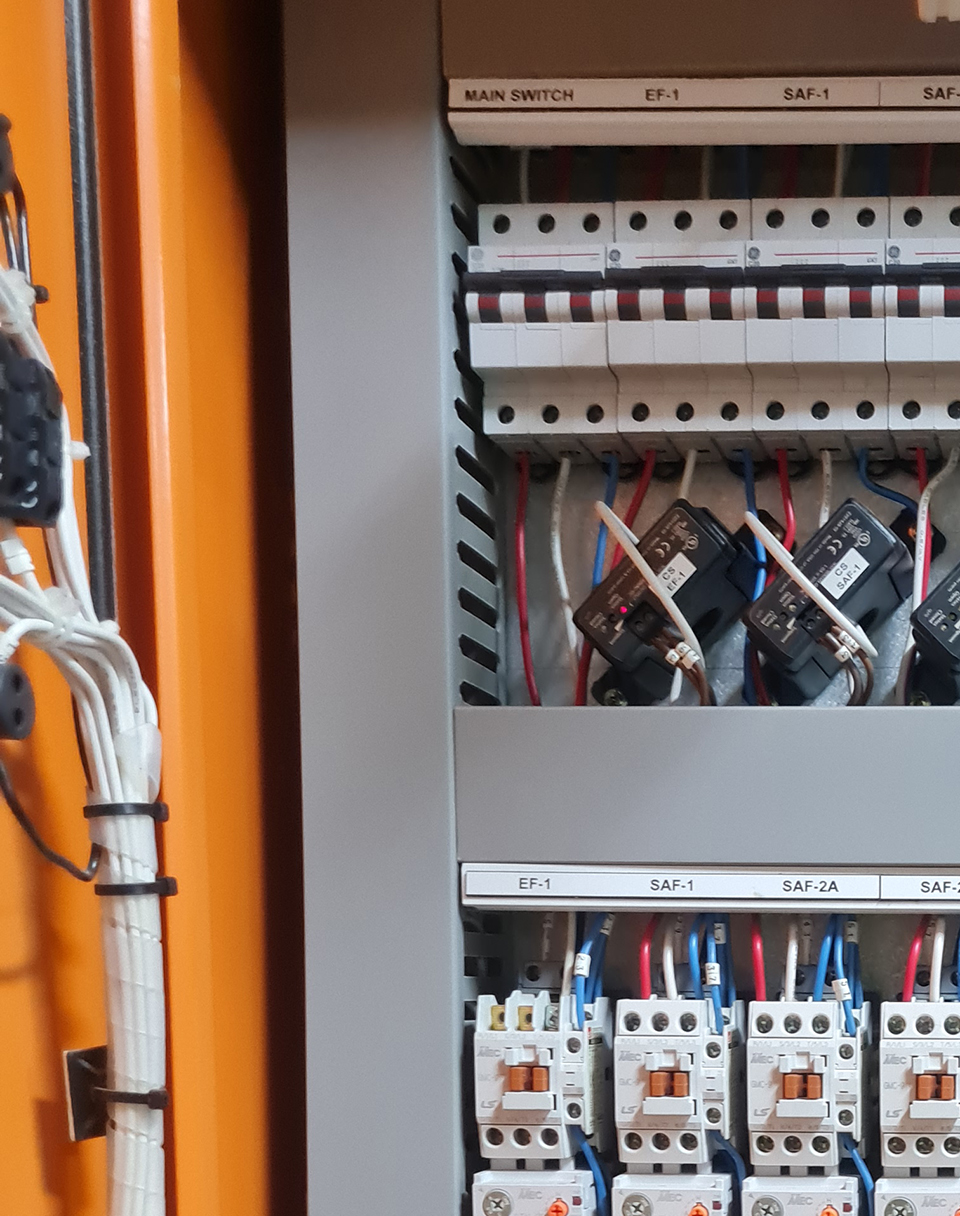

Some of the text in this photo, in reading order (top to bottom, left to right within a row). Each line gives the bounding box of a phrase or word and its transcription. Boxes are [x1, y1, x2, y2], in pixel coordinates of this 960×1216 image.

[465, 88, 574, 102] MAIN SWITCH
[645, 88, 680, 101] EF-1
[783, 87, 830, 100] SAF-1
[662, 567, 676, 581] CS
[834, 562, 849, 576] CS
[667, 571, 687, 592] EF-1
[837, 564, 861, 590] SAF-1
[518, 877, 552, 891] EF-1
[649, 878, 695, 893] SAF-1
[782, 879, 839, 893] SAF-2A
[708, 965, 717, 983] 37
